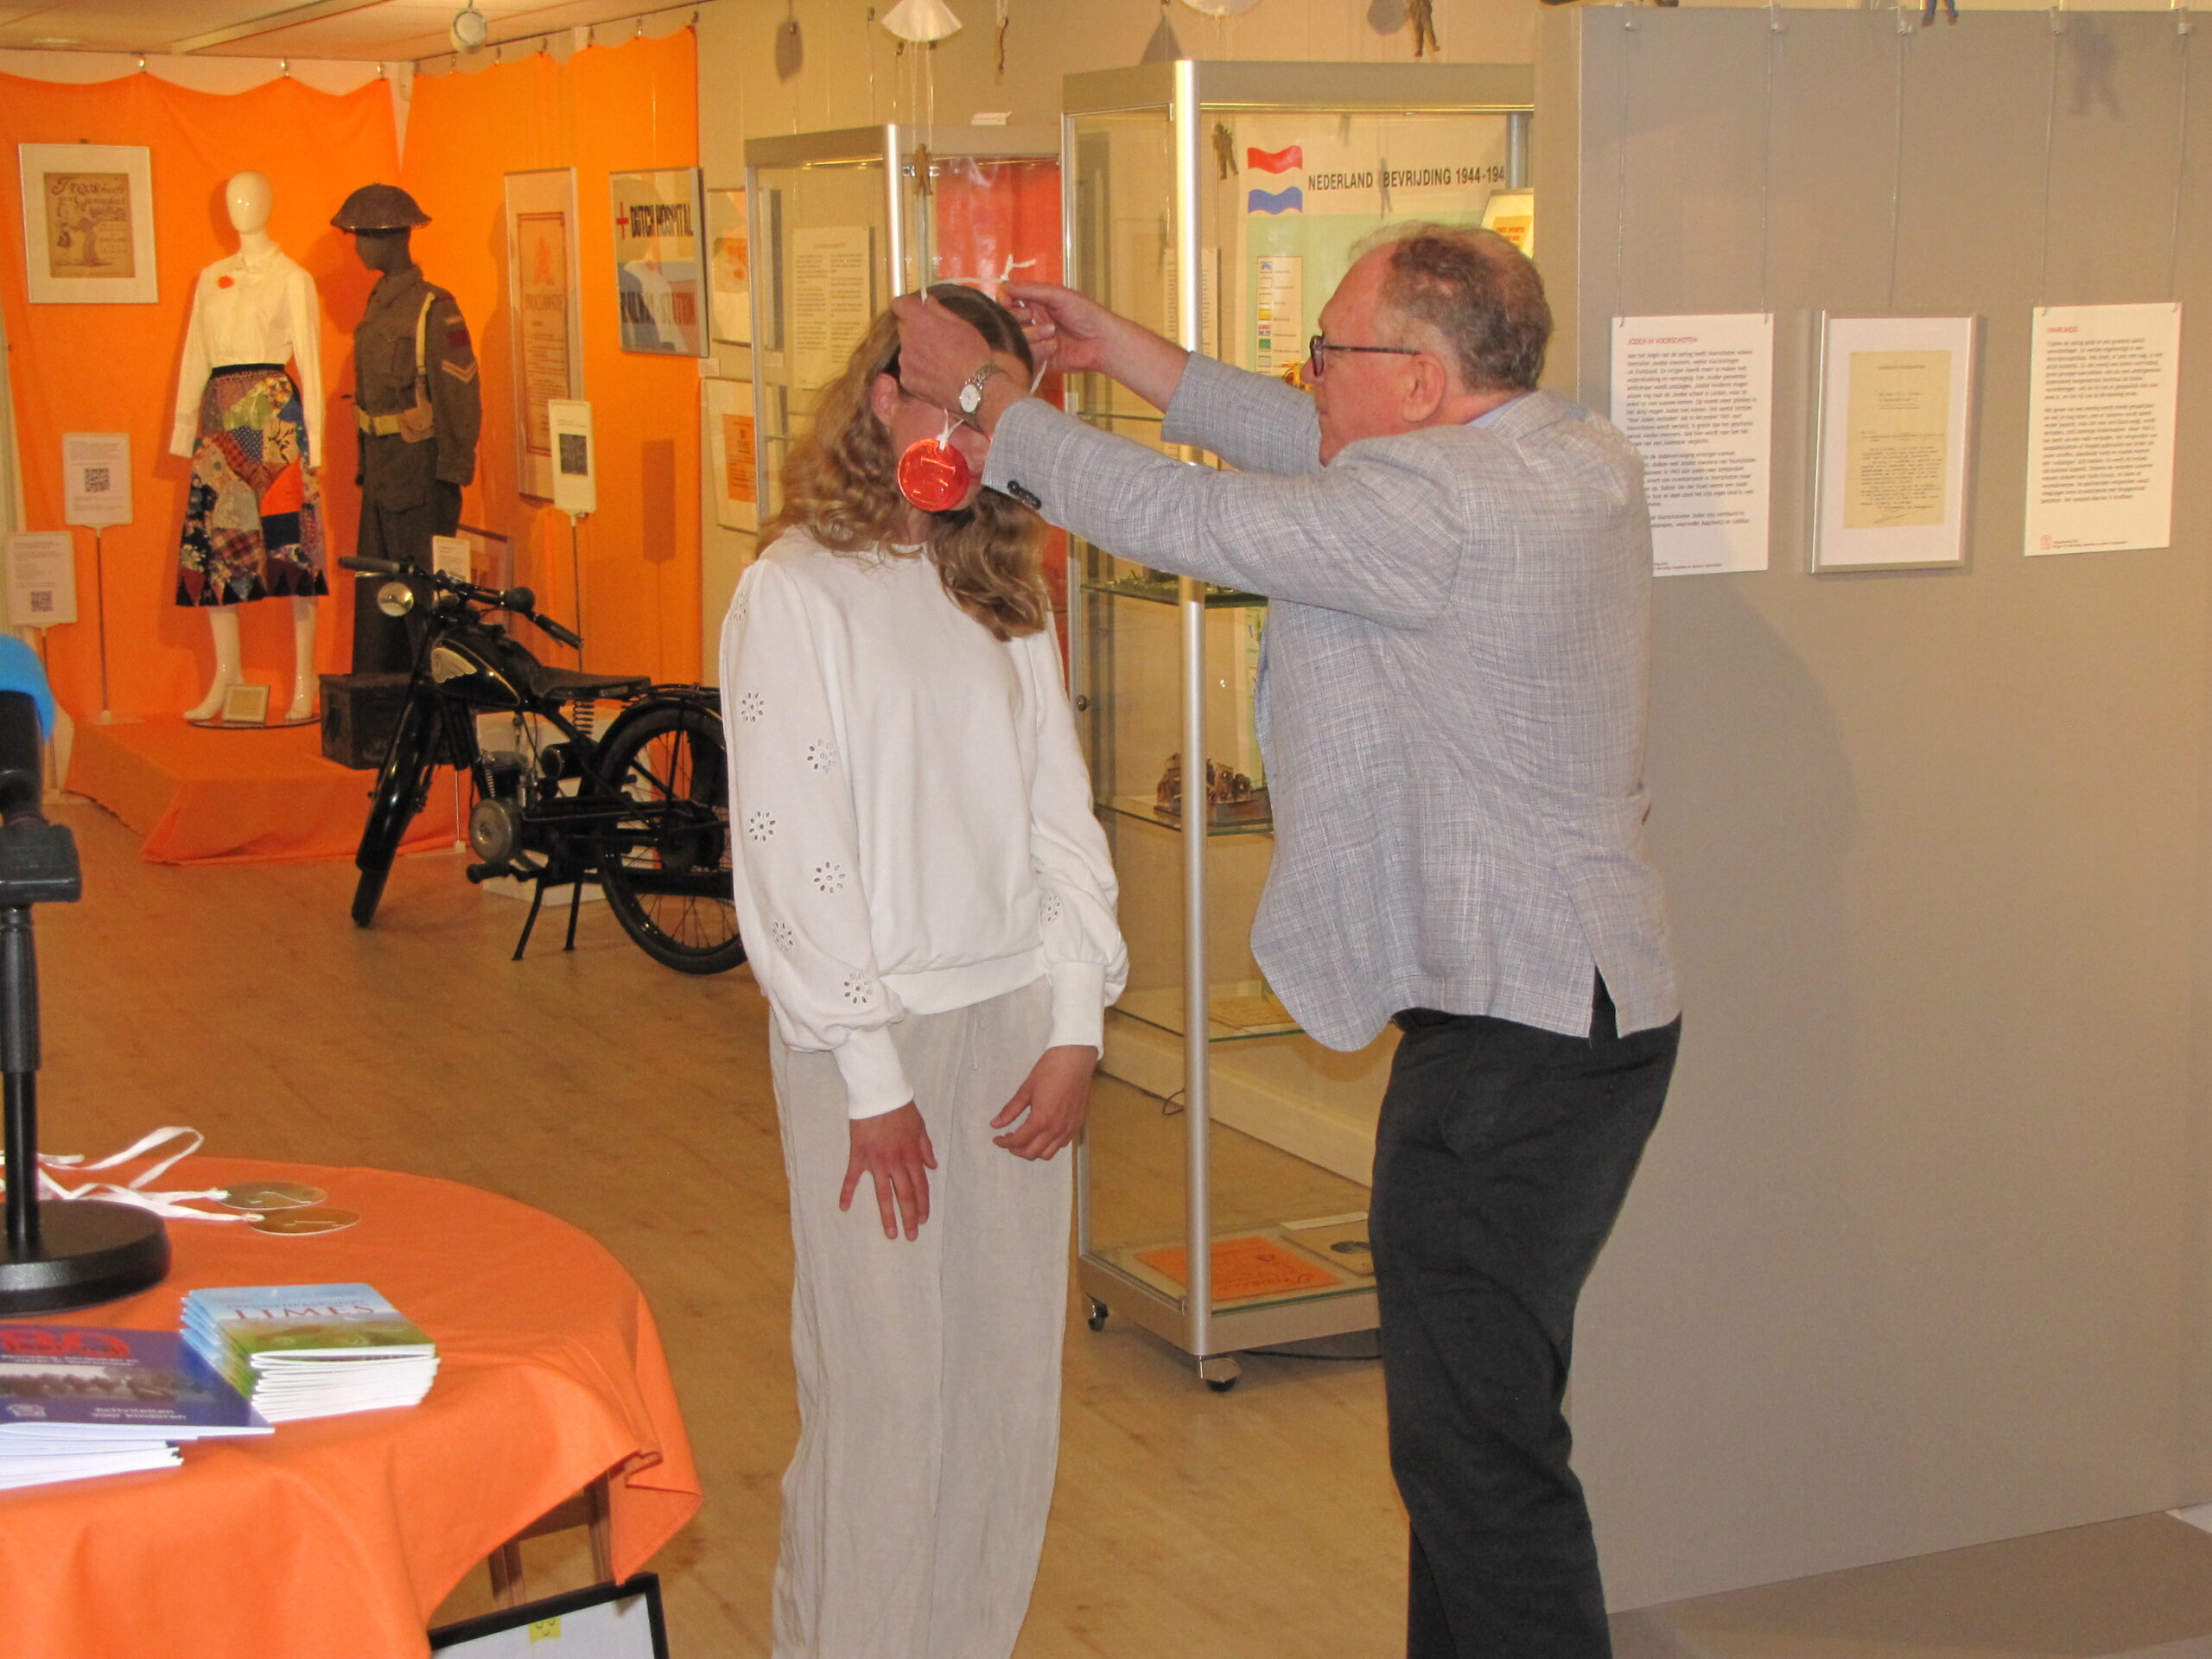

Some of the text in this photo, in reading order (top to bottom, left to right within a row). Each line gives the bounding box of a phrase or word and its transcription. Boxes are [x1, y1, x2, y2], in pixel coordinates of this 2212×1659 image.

[1308, 166, 1506, 190] NEDERLAND BEVRIJDING 1944-194
[1656, 336, 1698, 345] VOORSCHOTEN
[234, 1304, 375, 1319] LIMES
